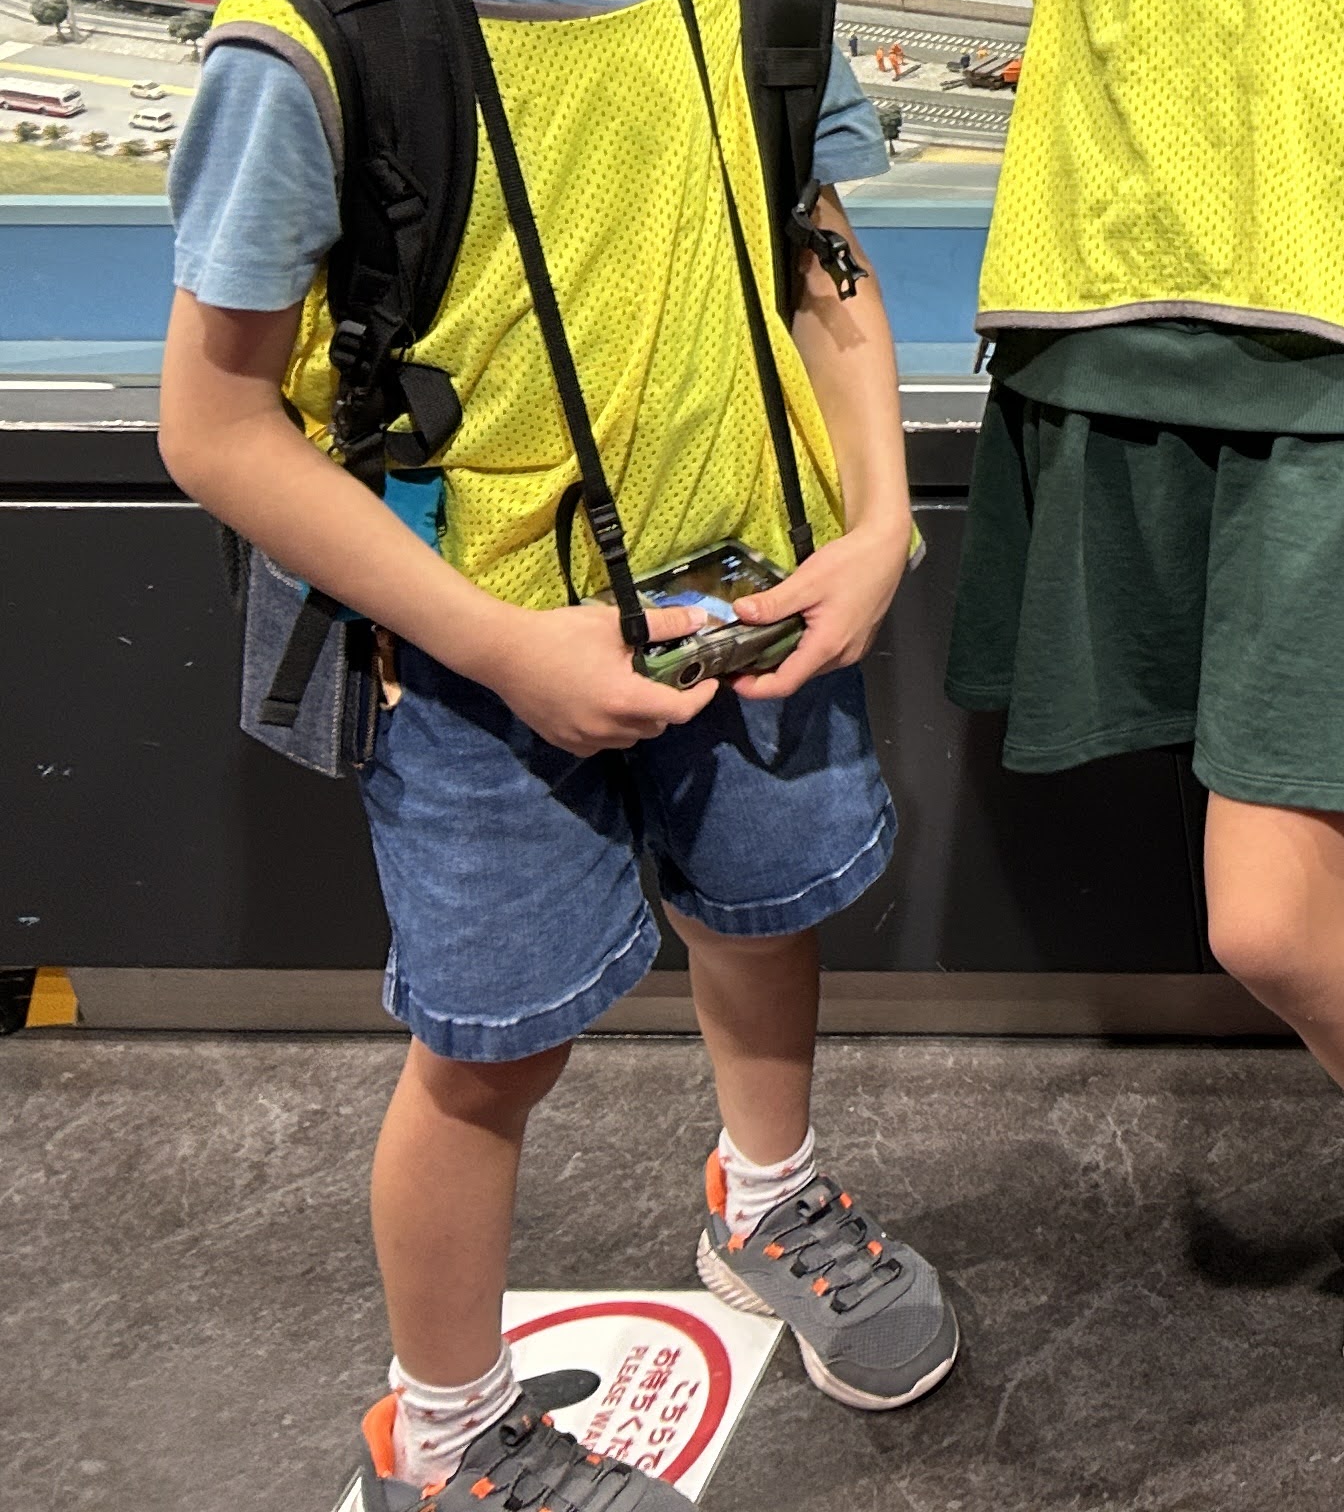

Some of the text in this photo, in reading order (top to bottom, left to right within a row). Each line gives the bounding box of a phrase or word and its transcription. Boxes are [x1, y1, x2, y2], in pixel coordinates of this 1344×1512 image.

[601, 1346, 649, 1405] PLEASE
[604, 1347, 681, 1460] お待ちくだ
[635, 1381, 701, 1469] こちらで
